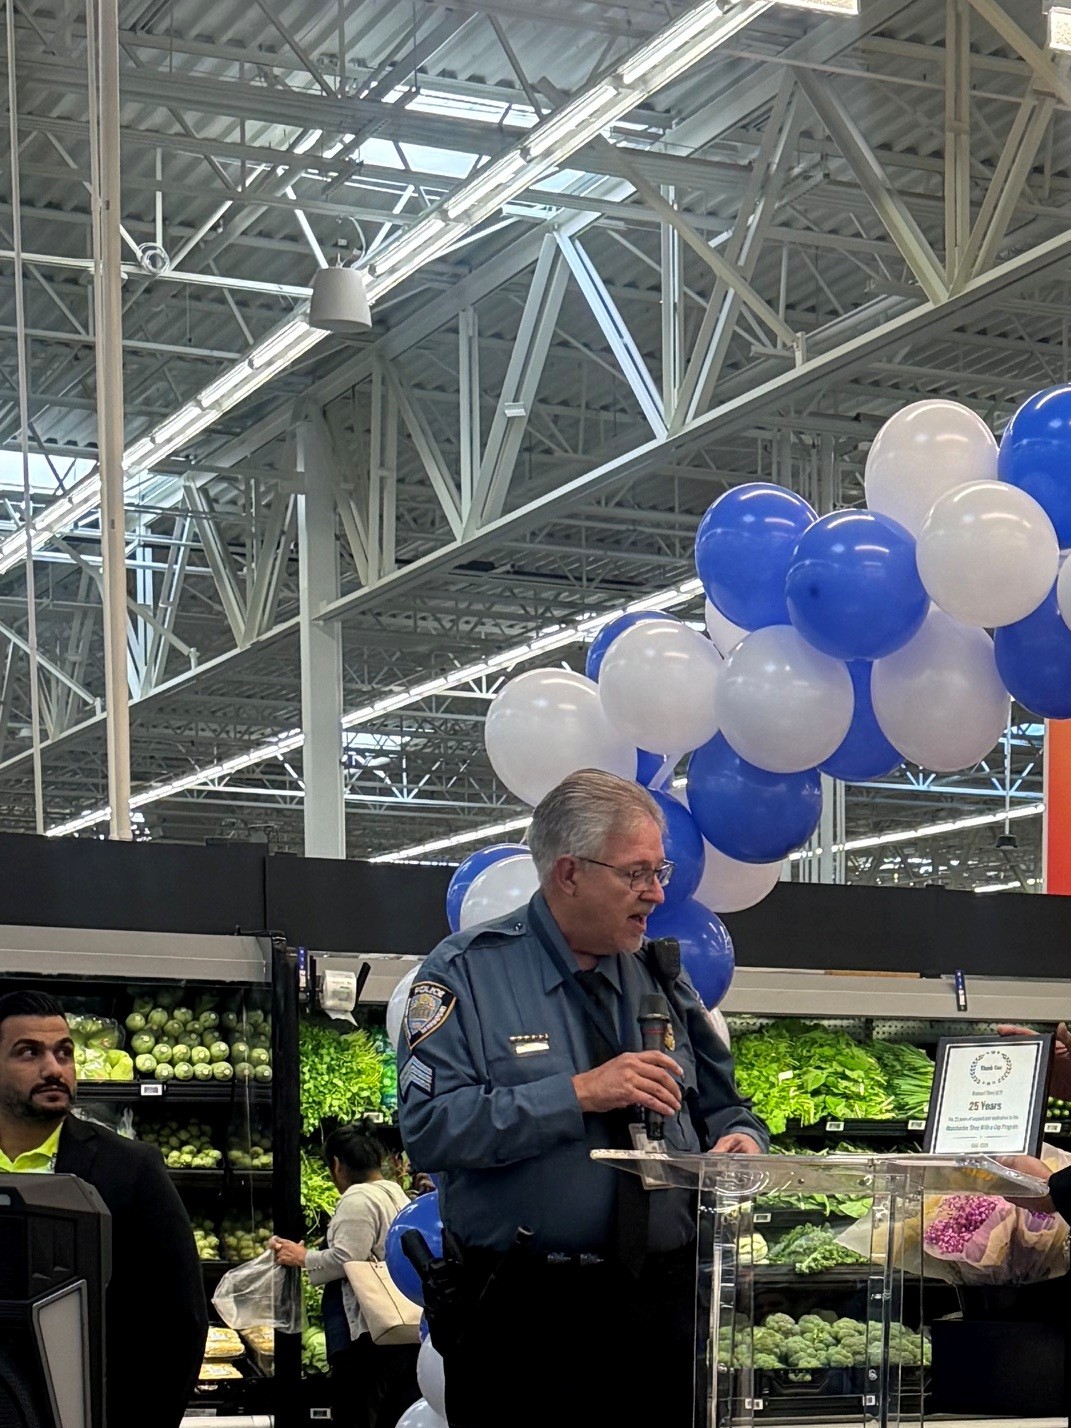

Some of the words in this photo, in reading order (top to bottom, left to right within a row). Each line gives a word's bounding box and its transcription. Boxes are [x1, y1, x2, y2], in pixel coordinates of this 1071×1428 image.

[415, 983, 446, 998] POLICE
[968, 1101, 979, 1111] 25
[981, 1100, 1002, 1111] Years
